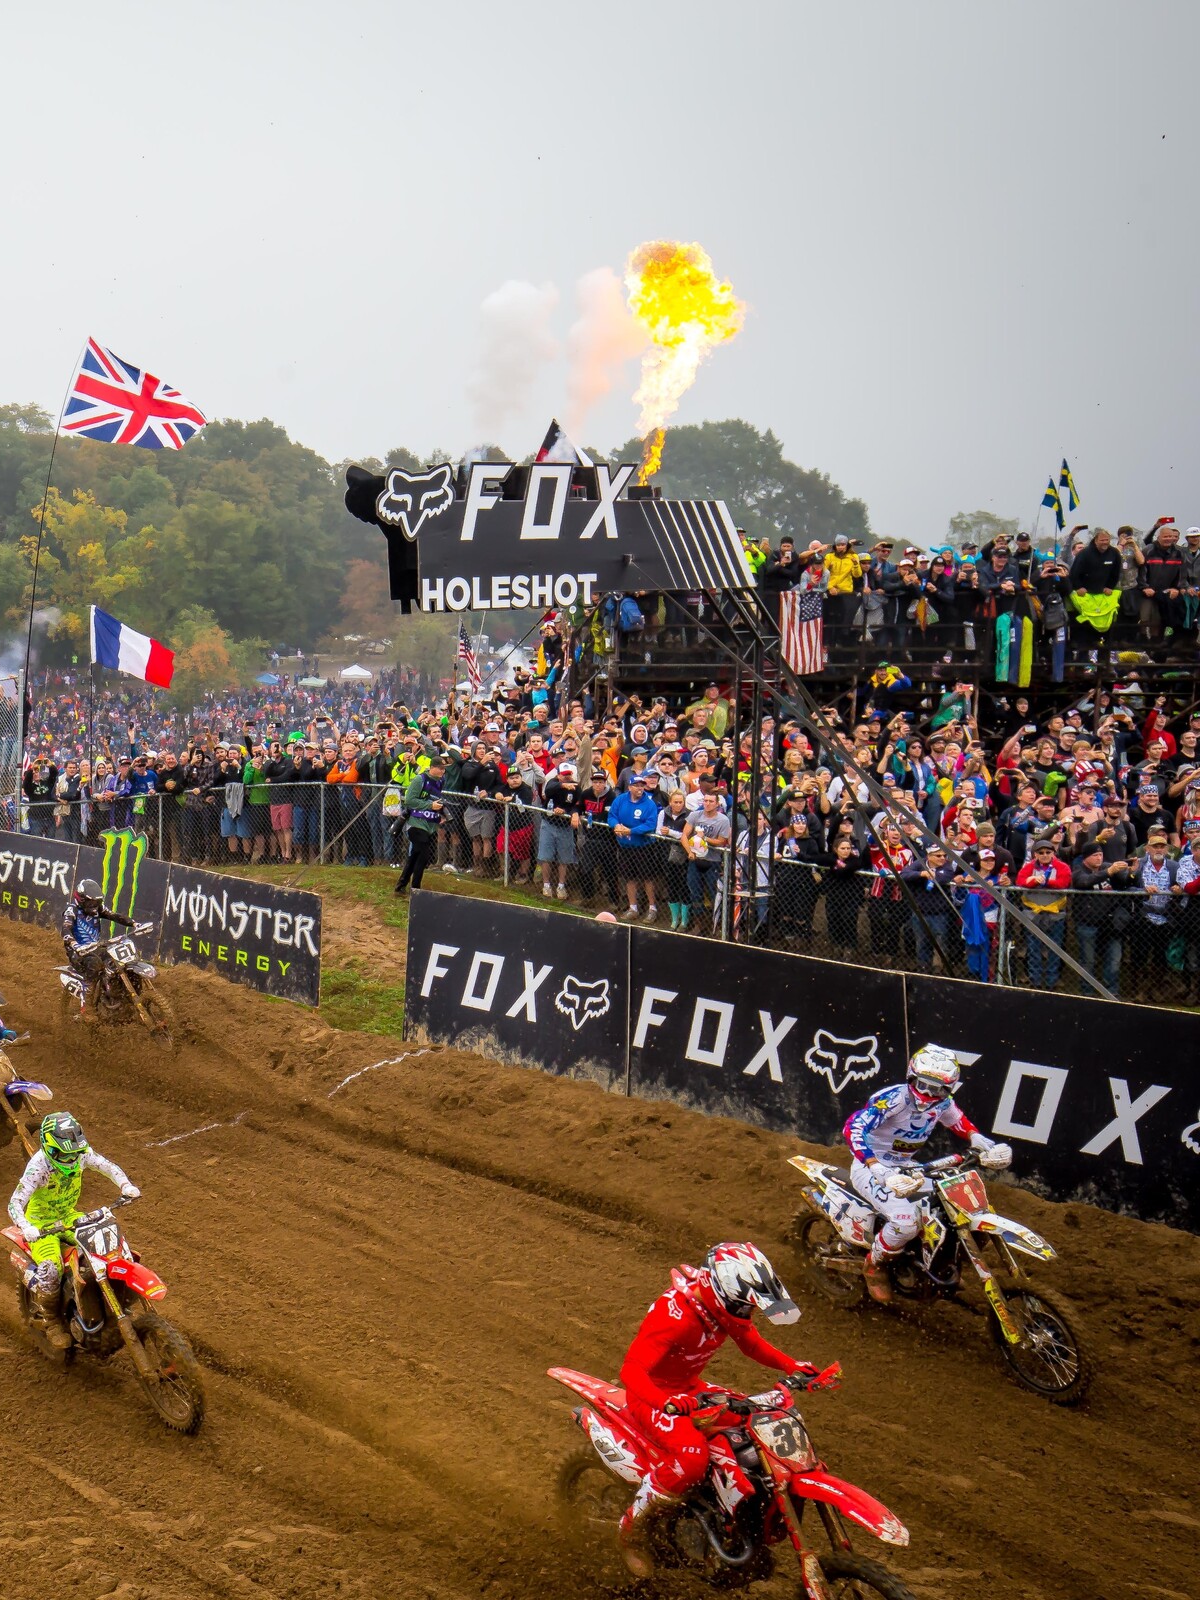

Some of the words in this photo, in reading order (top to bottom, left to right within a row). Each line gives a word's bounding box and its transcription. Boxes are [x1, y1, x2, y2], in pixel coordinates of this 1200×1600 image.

[460, 464, 628, 541] FOX
[422, 573, 598, 612] HOLESHOT
[114, 941, 135, 961] 61
[165, 884, 319, 957] MONSTER
[182, 936, 292, 977] ENERGY
[420, 943, 554, 1022] FOX
[632, 986, 798, 1083] FOX
[950, 1049, 1173, 1166] OX
[963, 1184, 979, 1208] 1
